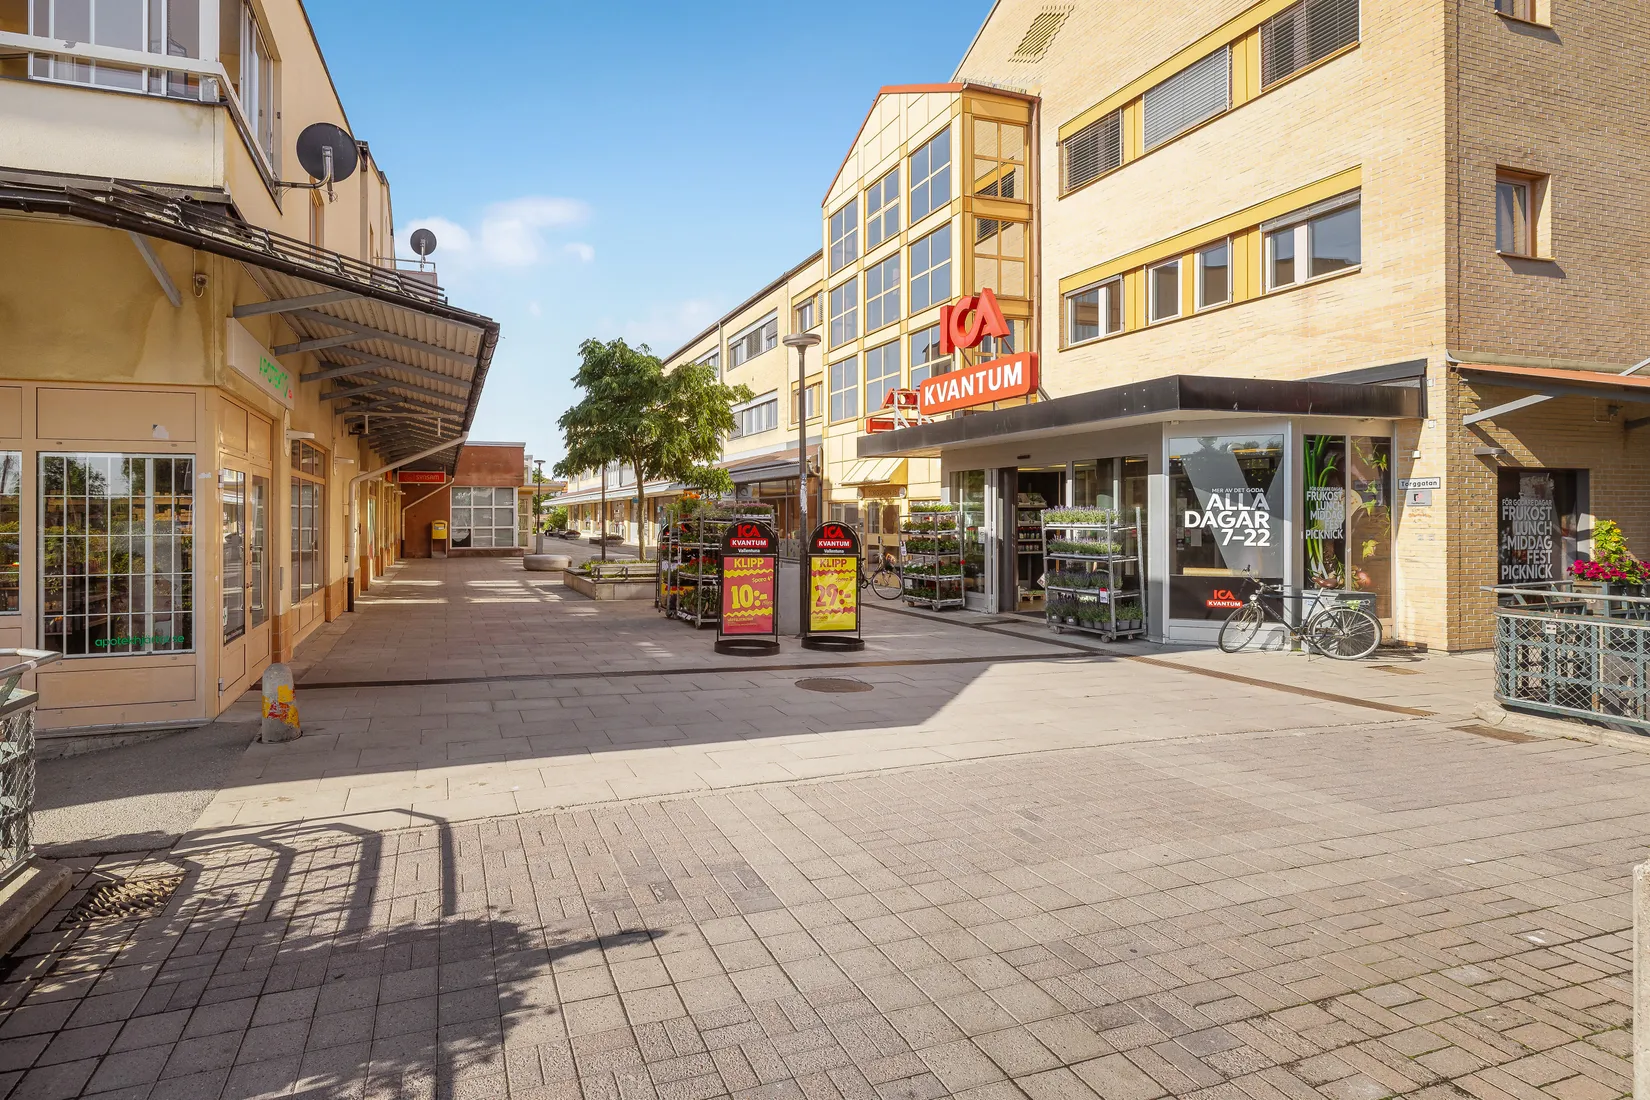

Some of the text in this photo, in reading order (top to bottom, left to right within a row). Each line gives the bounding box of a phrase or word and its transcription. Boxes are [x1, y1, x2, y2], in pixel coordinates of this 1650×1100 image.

[940, 287, 1010, 355] ICA
[924, 361, 1023, 406] KVANTUM
[1401, 480, 1438, 488] Torggatan
[1206, 493, 1270, 510] ALLA
[1306, 491, 1344, 501] FRUKOST
[1502, 497, 1512, 506] FÖR
[1315, 501, 1344, 511] LUNCH
[1184, 510, 1270, 528] DAGAR
[1310, 510, 1344, 520] MIDDAG
[1502, 506, 1553, 520] FRUKOST
[737, 524, 761, 537] ICA
[823, 525, 845, 538] ICA
[1325, 520, 1344, 530] FEST
[1515, 521, 1552, 536] LUNCH
[1305, 529, 1344, 540] PICKNICK
[1507, 535, 1553, 550] MIDDAG
[734, 558, 765, 568] KLIPP
[820, 559, 848, 568] KLIPP
[1527, 550, 1553, 565] FEST
[1501, 564, 1554, 580] PICKNICK
[1213, 589, 1236, 600] ICA
